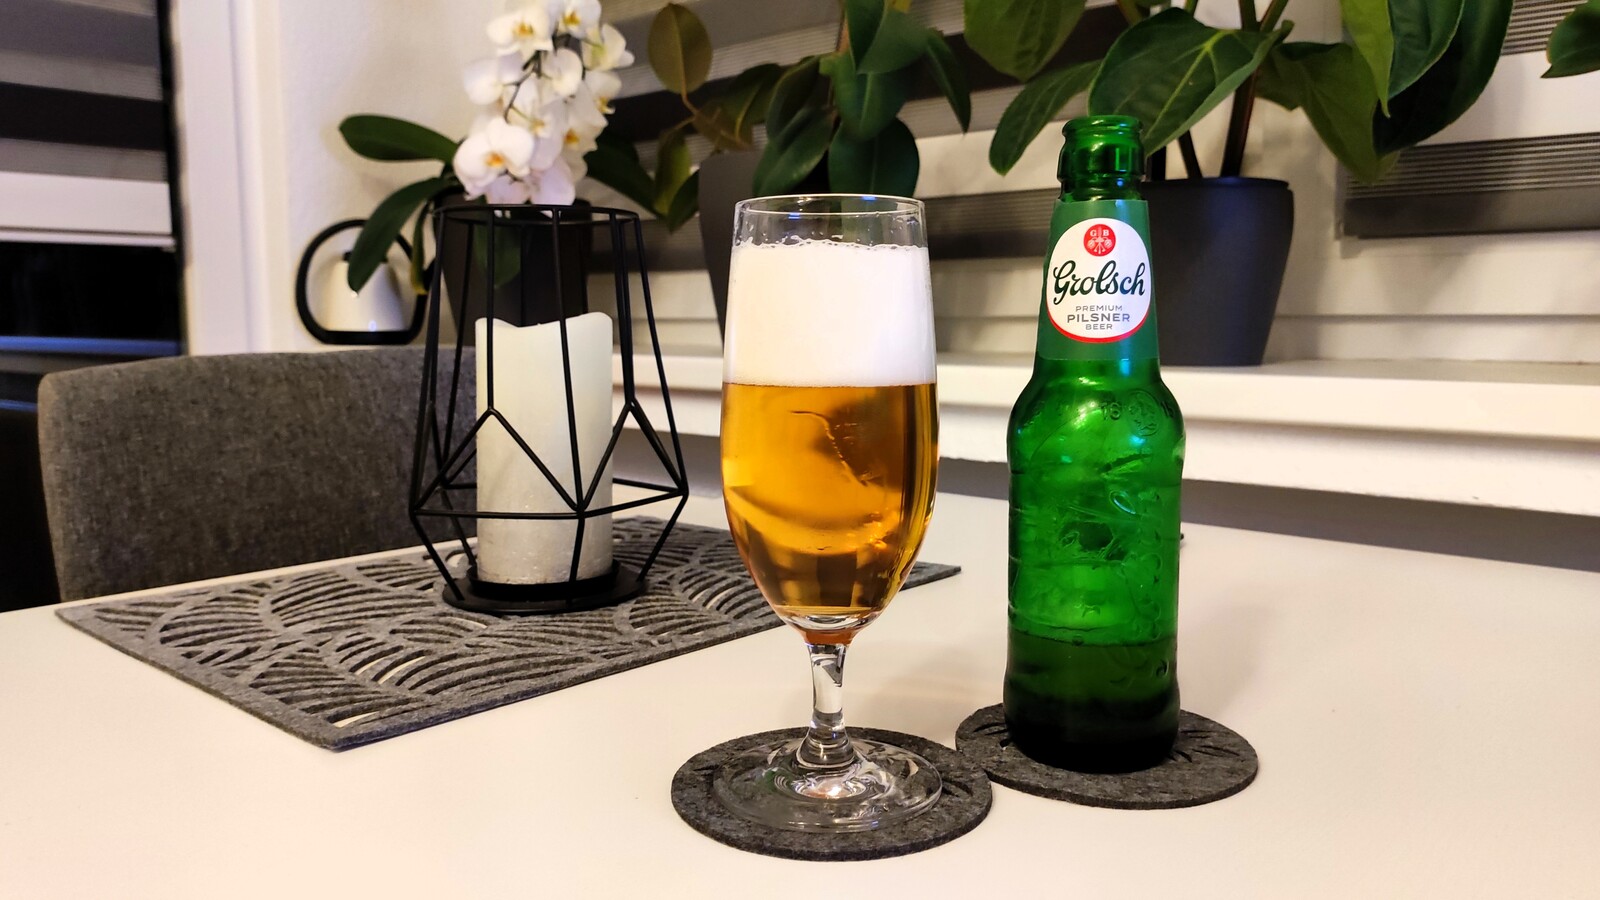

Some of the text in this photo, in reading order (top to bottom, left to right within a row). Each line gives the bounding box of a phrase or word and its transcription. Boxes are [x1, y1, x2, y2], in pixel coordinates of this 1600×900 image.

[1089, 229, 1110, 237] G B
[1053, 260, 1146, 305] Grolsch
[1067, 313, 1130, 323] PILSNER
